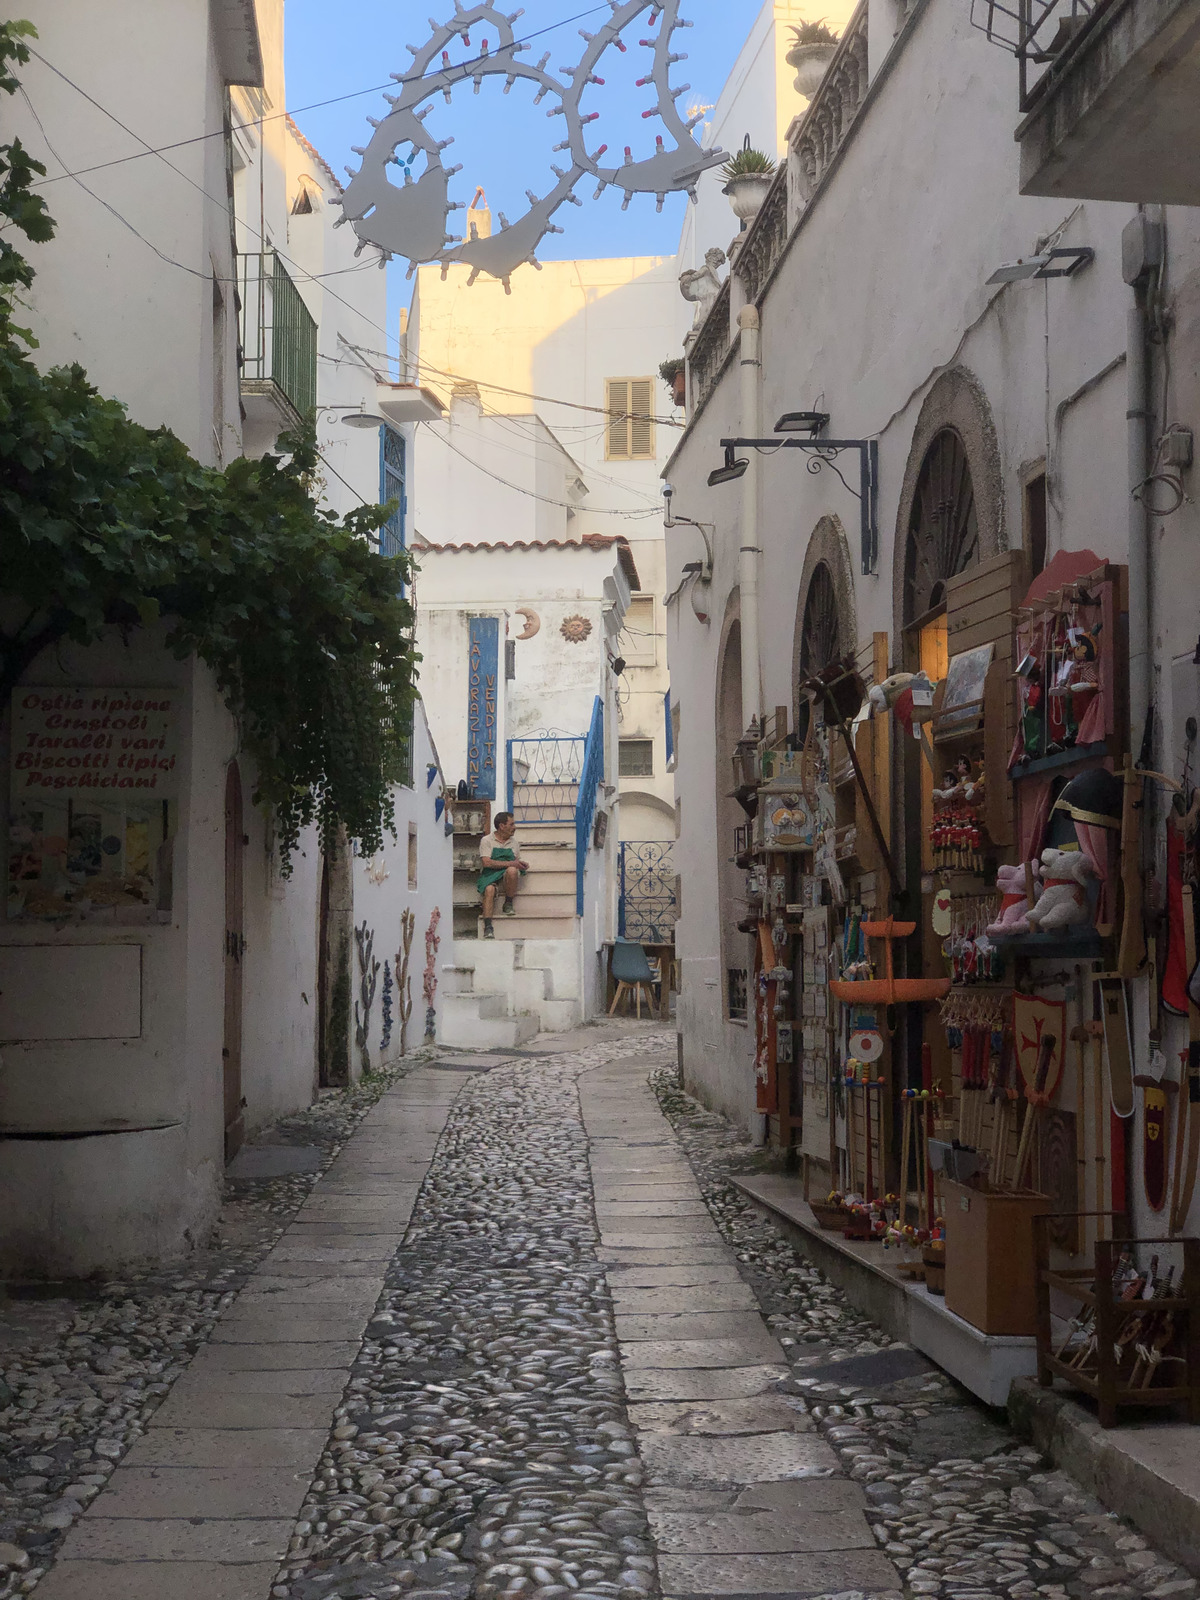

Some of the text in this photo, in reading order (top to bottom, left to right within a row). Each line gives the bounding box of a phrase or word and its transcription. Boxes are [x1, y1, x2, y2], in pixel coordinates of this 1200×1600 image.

[92, 695, 171, 713] ripiene
[469, 631, 480, 789] LAVORAZIONE
[45, 714, 148, 731] Crustoli
[484, 674, 495, 769] VENDITA
[26, 733, 166, 750] Taralli vari
[15, 752, 176, 772] Biscotti tipici
[25, 772, 158, 789] Peschiciani
